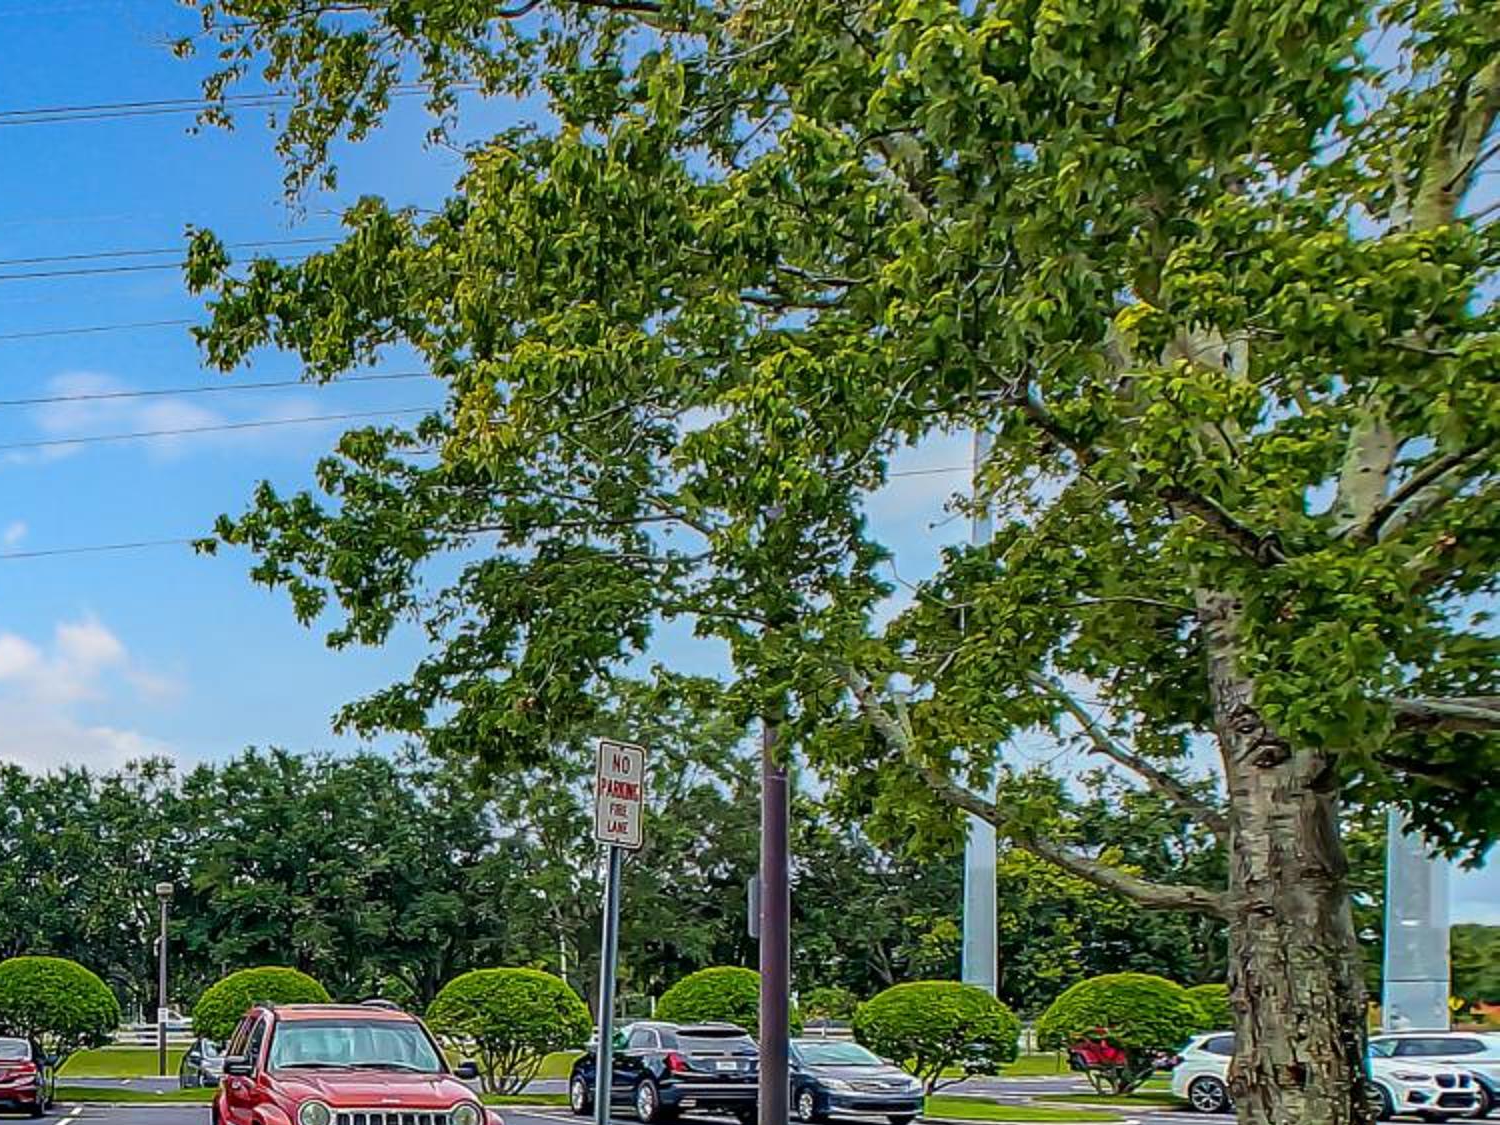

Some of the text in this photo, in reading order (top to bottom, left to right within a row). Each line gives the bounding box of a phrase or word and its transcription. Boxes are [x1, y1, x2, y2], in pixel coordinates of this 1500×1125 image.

[611, 753, 631, 774] NO
[601, 777, 639, 802] PARKING
[610, 803, 628, 819] FIRE
[607, 820, 629, 834] LANE
